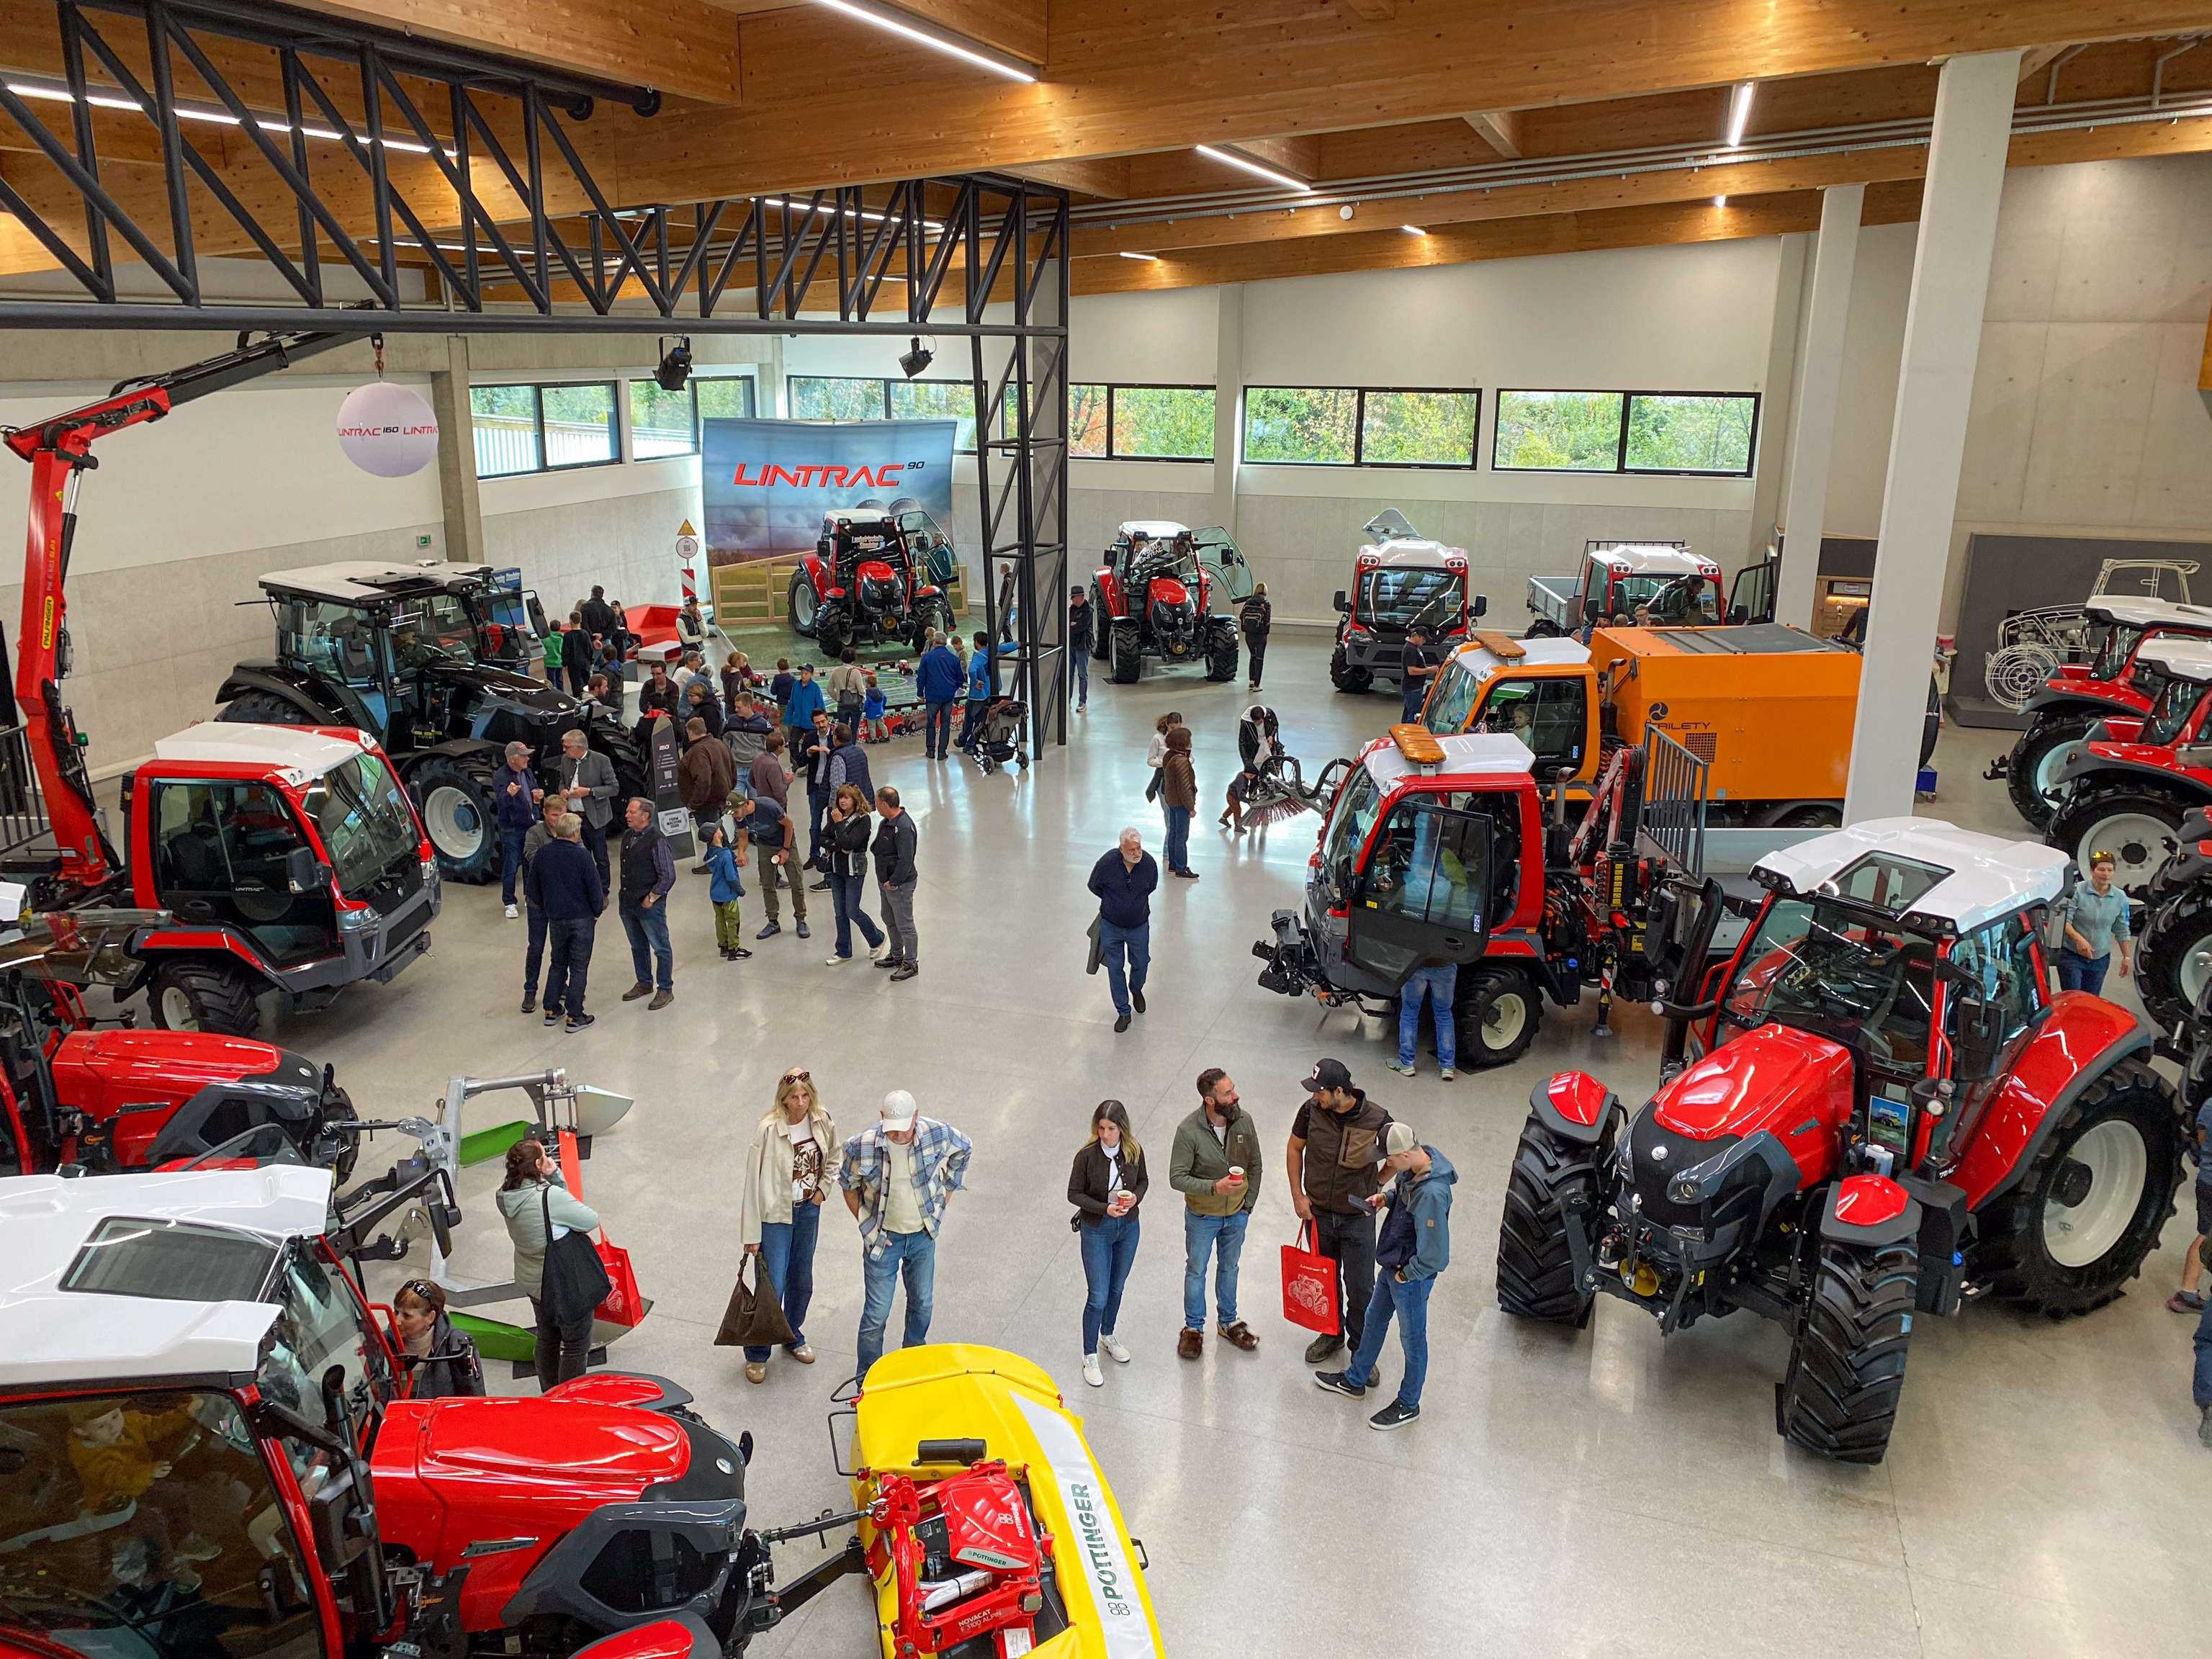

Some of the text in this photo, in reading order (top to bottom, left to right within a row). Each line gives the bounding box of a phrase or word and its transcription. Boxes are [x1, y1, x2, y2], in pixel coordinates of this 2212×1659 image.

[403, 426, 439, 435] LINTRA
[734, 461, 925, 487] LINTRAC 90
[43, 599, 53, 646] PALFINGER
[958, 1608, 992, 1627] NOVACAT
